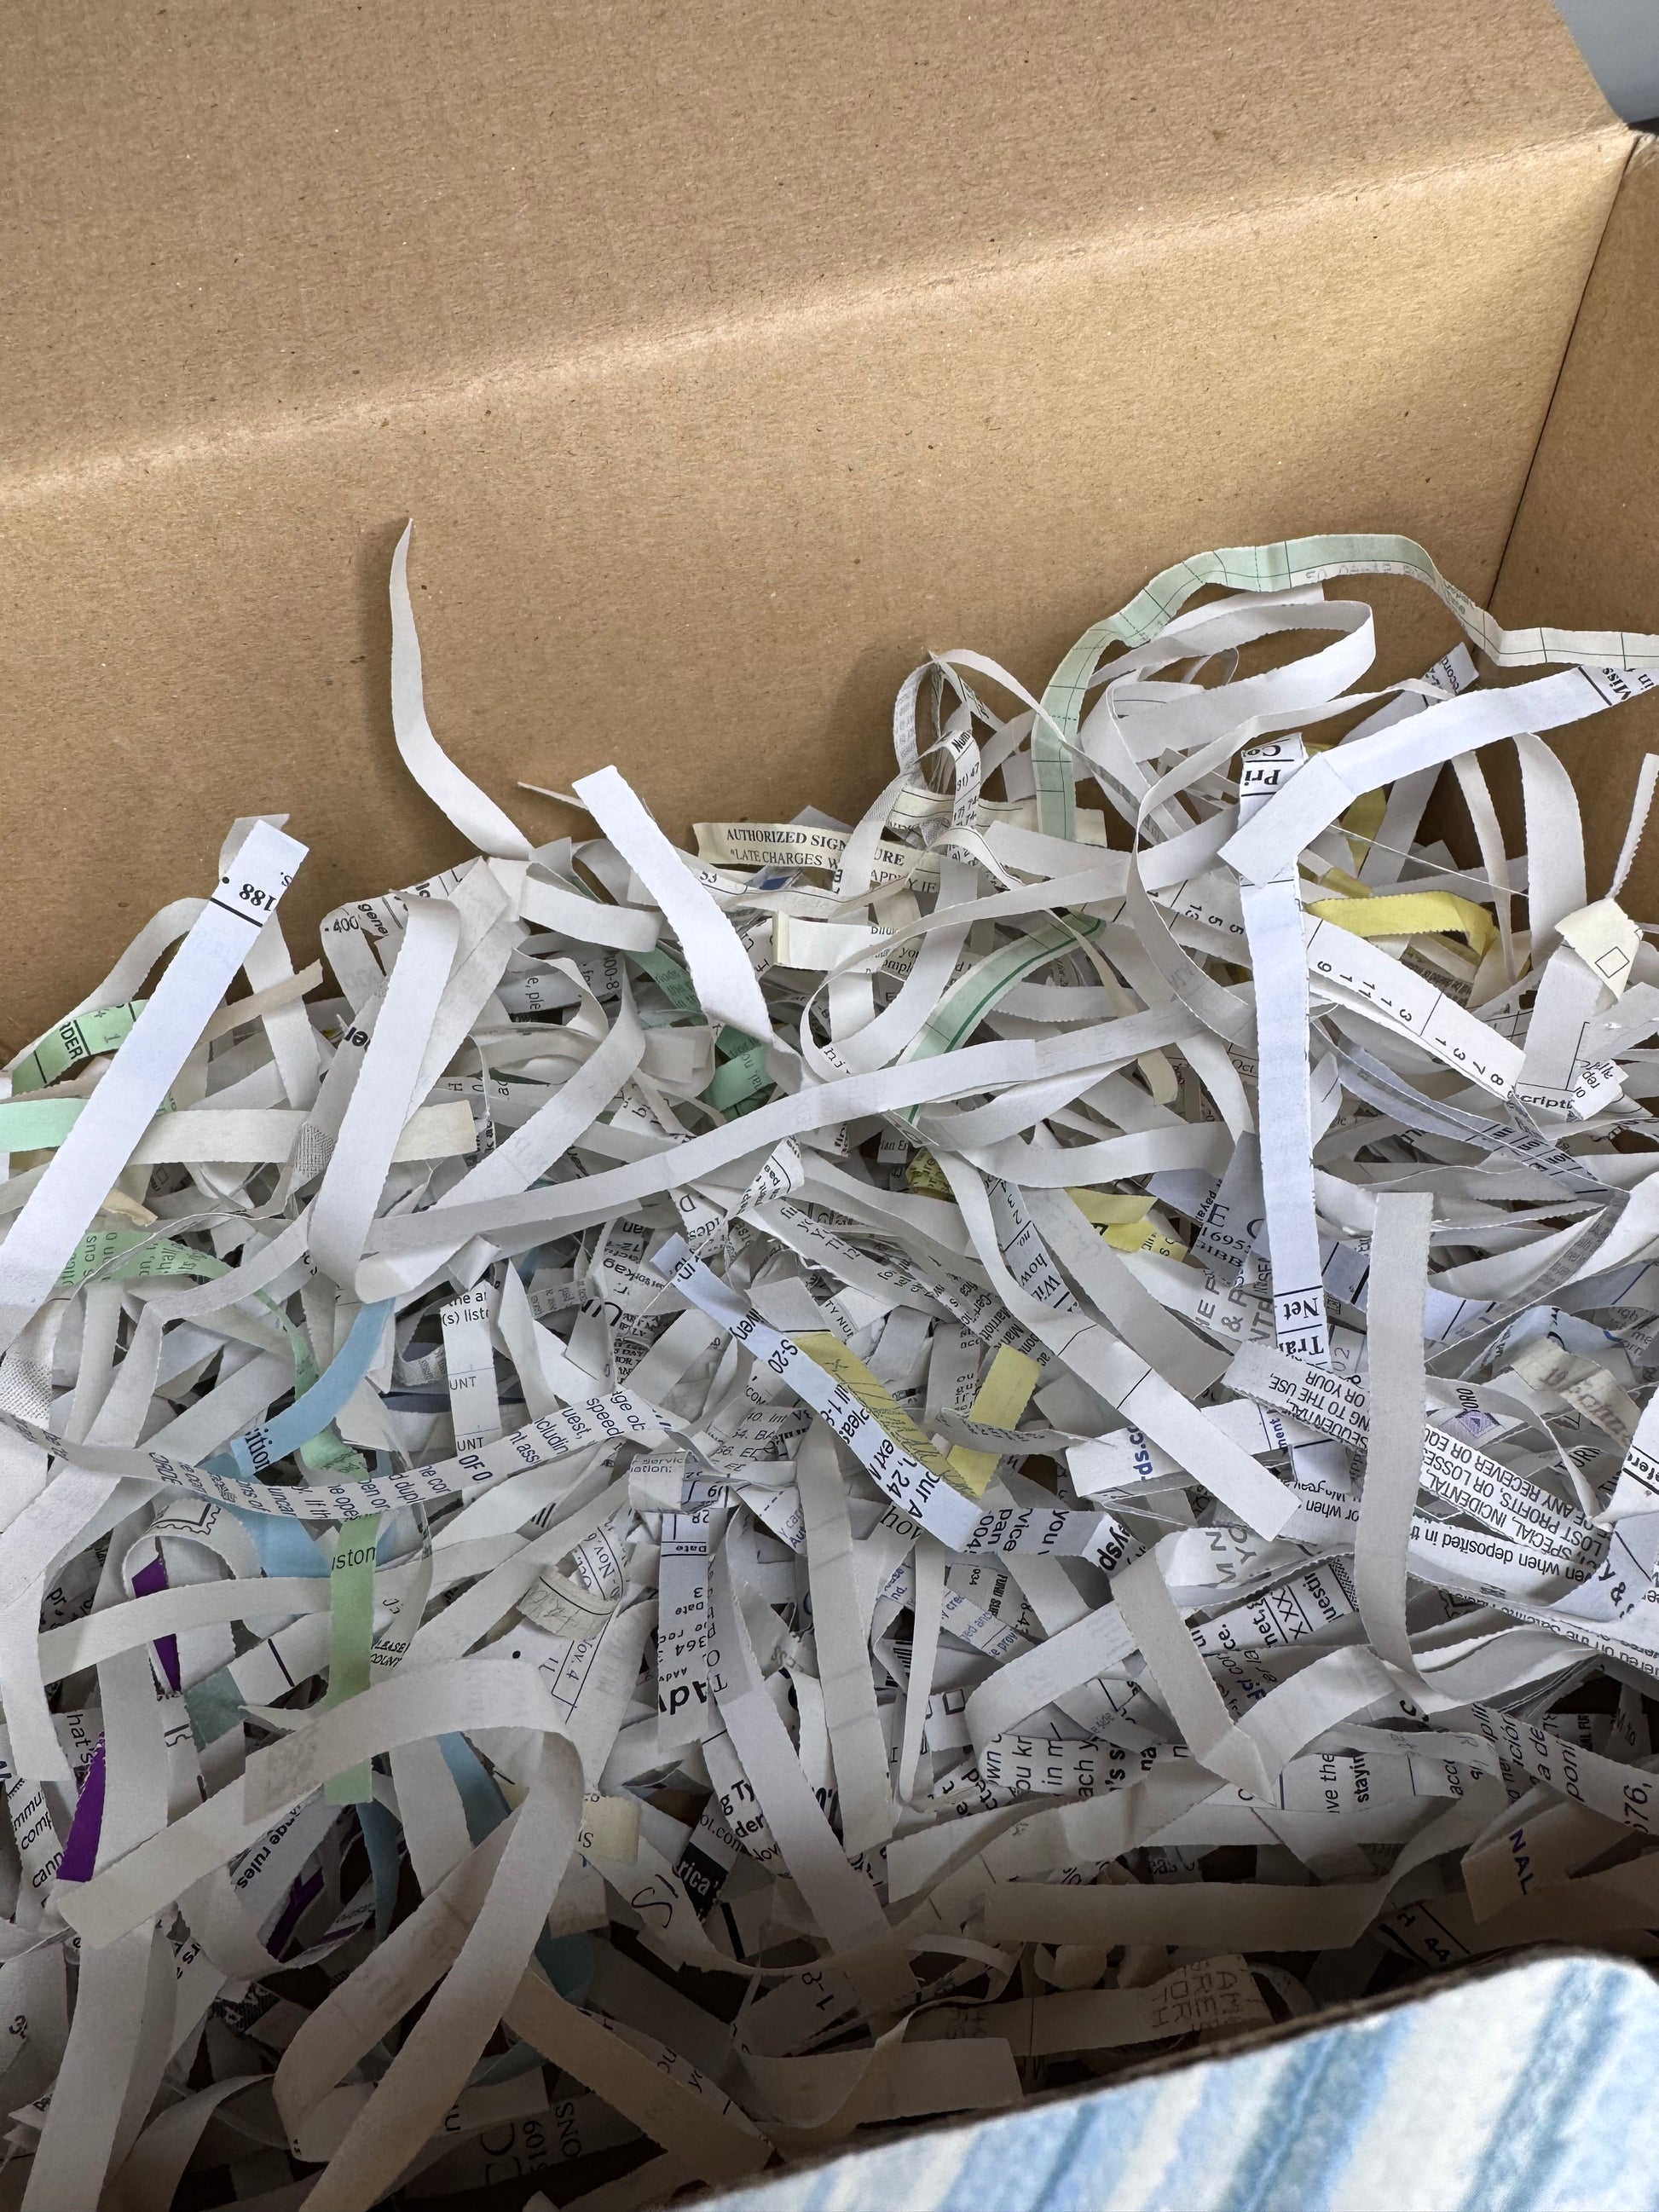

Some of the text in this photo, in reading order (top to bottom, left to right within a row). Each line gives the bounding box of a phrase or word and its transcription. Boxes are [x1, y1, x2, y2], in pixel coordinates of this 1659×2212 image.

[1244, 769, 1281, 786] Pri
[726, 829, 807, 846] AUTHORIZED
[762, 851, 823, 868] CHARGES
[239, 883, 277, 911] 188
[1398, 1008, 1413, 1023] 3
[1453, 1048, 1465, 1061] 3
[1471, 1060, 1486, 1076] 7
[1490, 1072, 1505, 1087] 8
[442, 1312, 461, 1326] (s)
[824, 1300, 840, 1316] TY
[1283, 1297, 1321, 1321] Net
[766, 1337, 800, 1375] S-20
[448, 1375, 477, 1391] UNT
[1269, 1372, 1299, 1396] USE,
[1306, 1370, 1367, 1408] OR YOUR
[1298, 1386, 1326, 1407] THE
[587, 1397, 623, 1439] speed
[1327, 1399, 1346, 1421] TO
[561, 1406, 591, 1441] uest,
[457, 1435, 485, 1453] UNT
[887, 1470, 910, 1499] 24
[1449, 1442, 1474, 1464] OR
[1473, 1453, 1541, 1499] RECEIVER
[1540, 1490, 1574, 1517] ANY
[907, 1501, 924, 1521] A
[1305, 1499, 1343, 1521] when
[1425, 1468, 1509, 1528] INCIDENTAL,
[1511, 1516, 1574, 1561] SPECIAL,
[1474, 1476, 1500, 1499] OR
[1500, 1487, 1569, 1540] PROFITS,
[1569, 1528, 1604, 1558] LOST
[1041, 1508, 1068, 1547] you
[675, 1545, 708, 1554] Date
[1424, 1528, 1563, 1577] in deposited when
[674, 1602, 705, 1616] Date
[1046, 1765, 1065, 1787] in
[1319, 1753, 1339, 1785] the
[236, 1845, 272, 1890] rules
[555, 2099, 583, 2159] ONS
